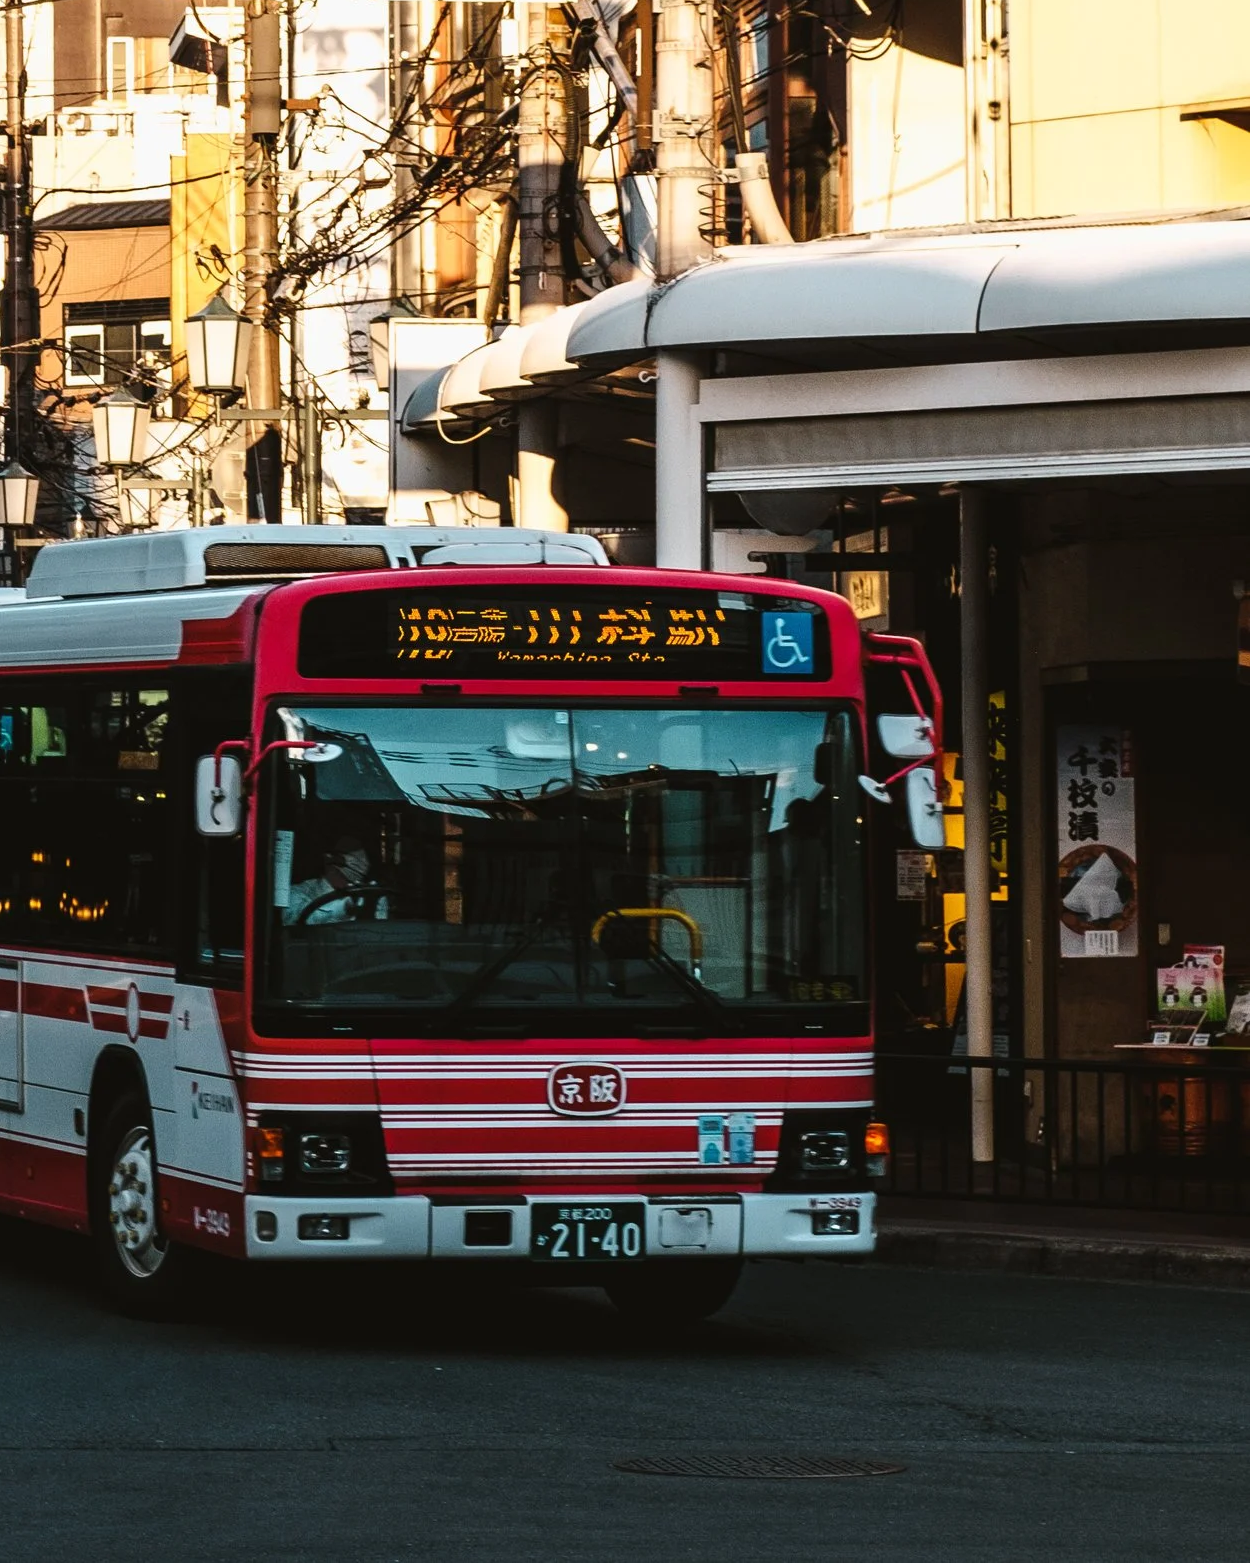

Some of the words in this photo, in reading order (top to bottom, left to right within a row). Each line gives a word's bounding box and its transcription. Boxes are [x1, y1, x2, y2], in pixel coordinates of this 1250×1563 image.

[198, 1091, 235, 1114] KEIHAN
[556, 1073, 618, 1105] 京阪
[557, 1207, 613, 1220] 京都200
[550, 1222, 641, 1257] 21-40
